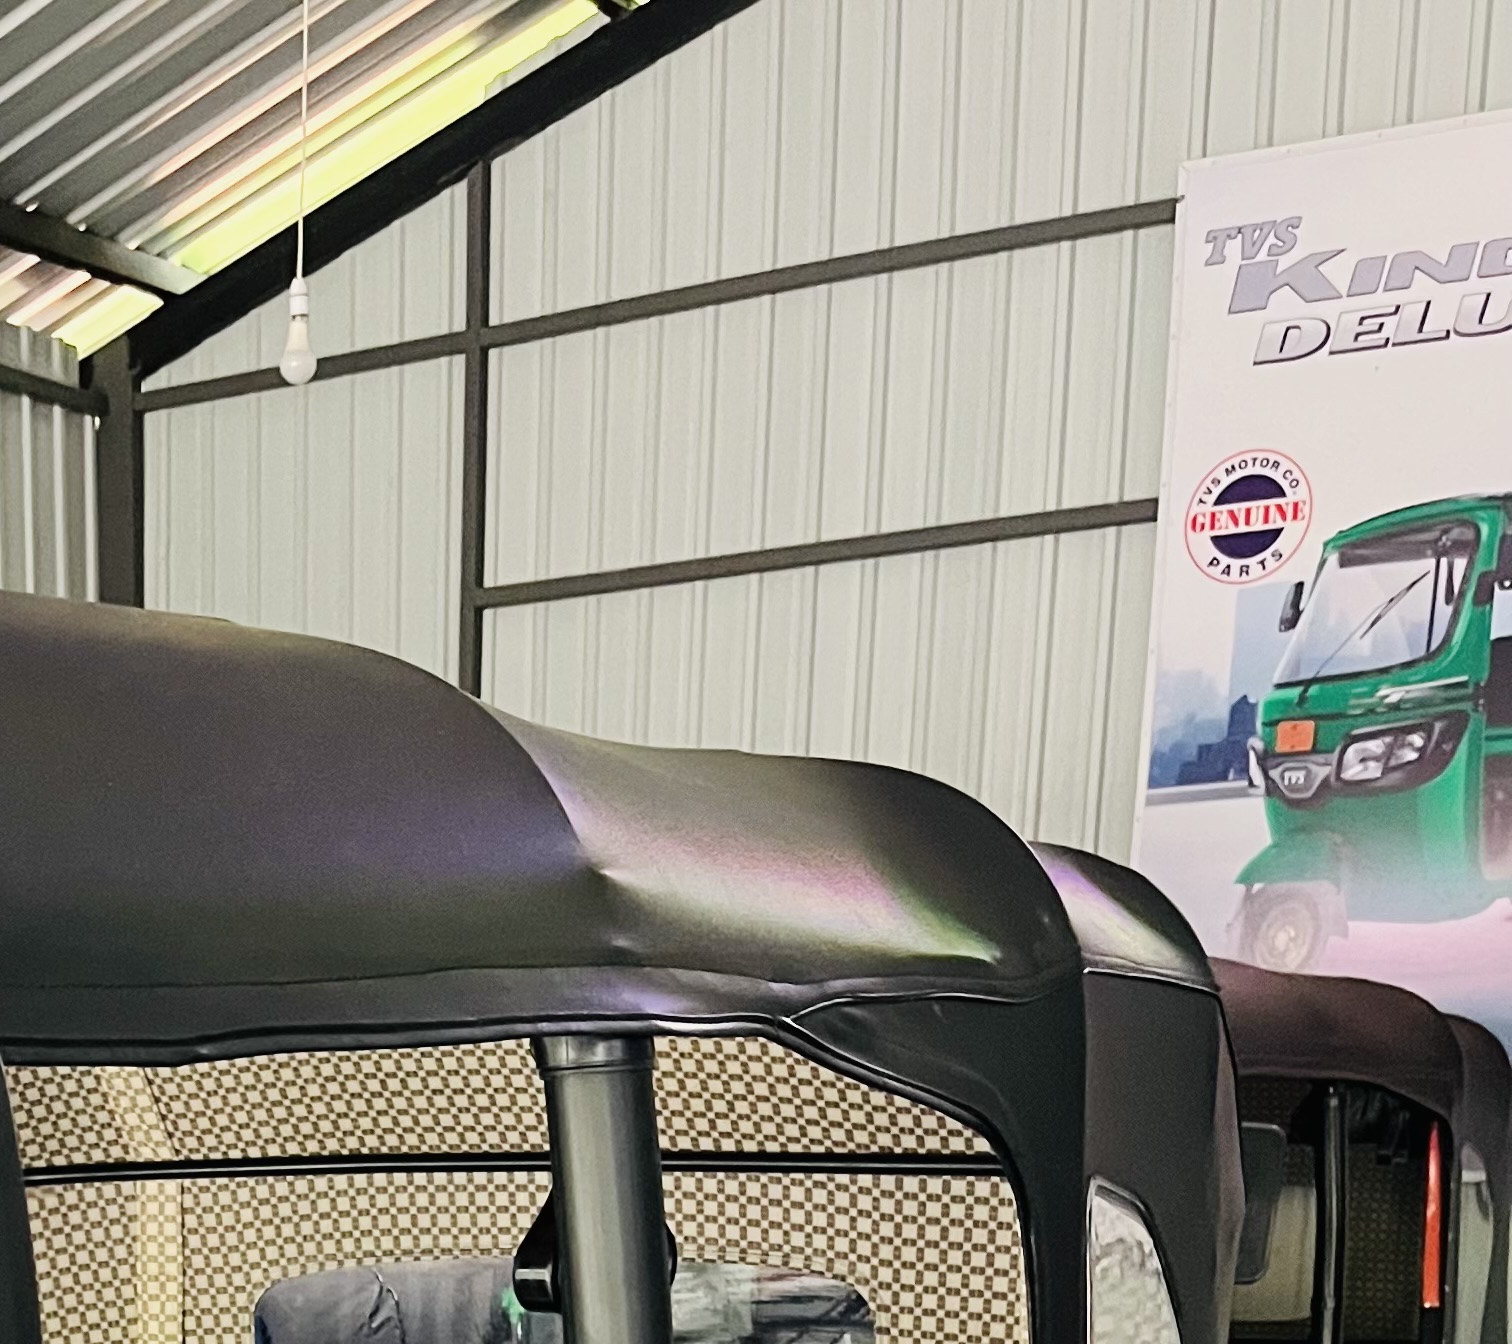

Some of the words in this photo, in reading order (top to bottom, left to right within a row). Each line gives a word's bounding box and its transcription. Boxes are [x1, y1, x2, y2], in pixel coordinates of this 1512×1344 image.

[1204, 216, 1303, 267] TVS
[1197, 477, 1221, 507] TVS
[1224, 457, 1281, 477] MOTOR
[1190, 500, 1307, 534] GENUINE
[1207, 549, 1283, 578] PARTS
